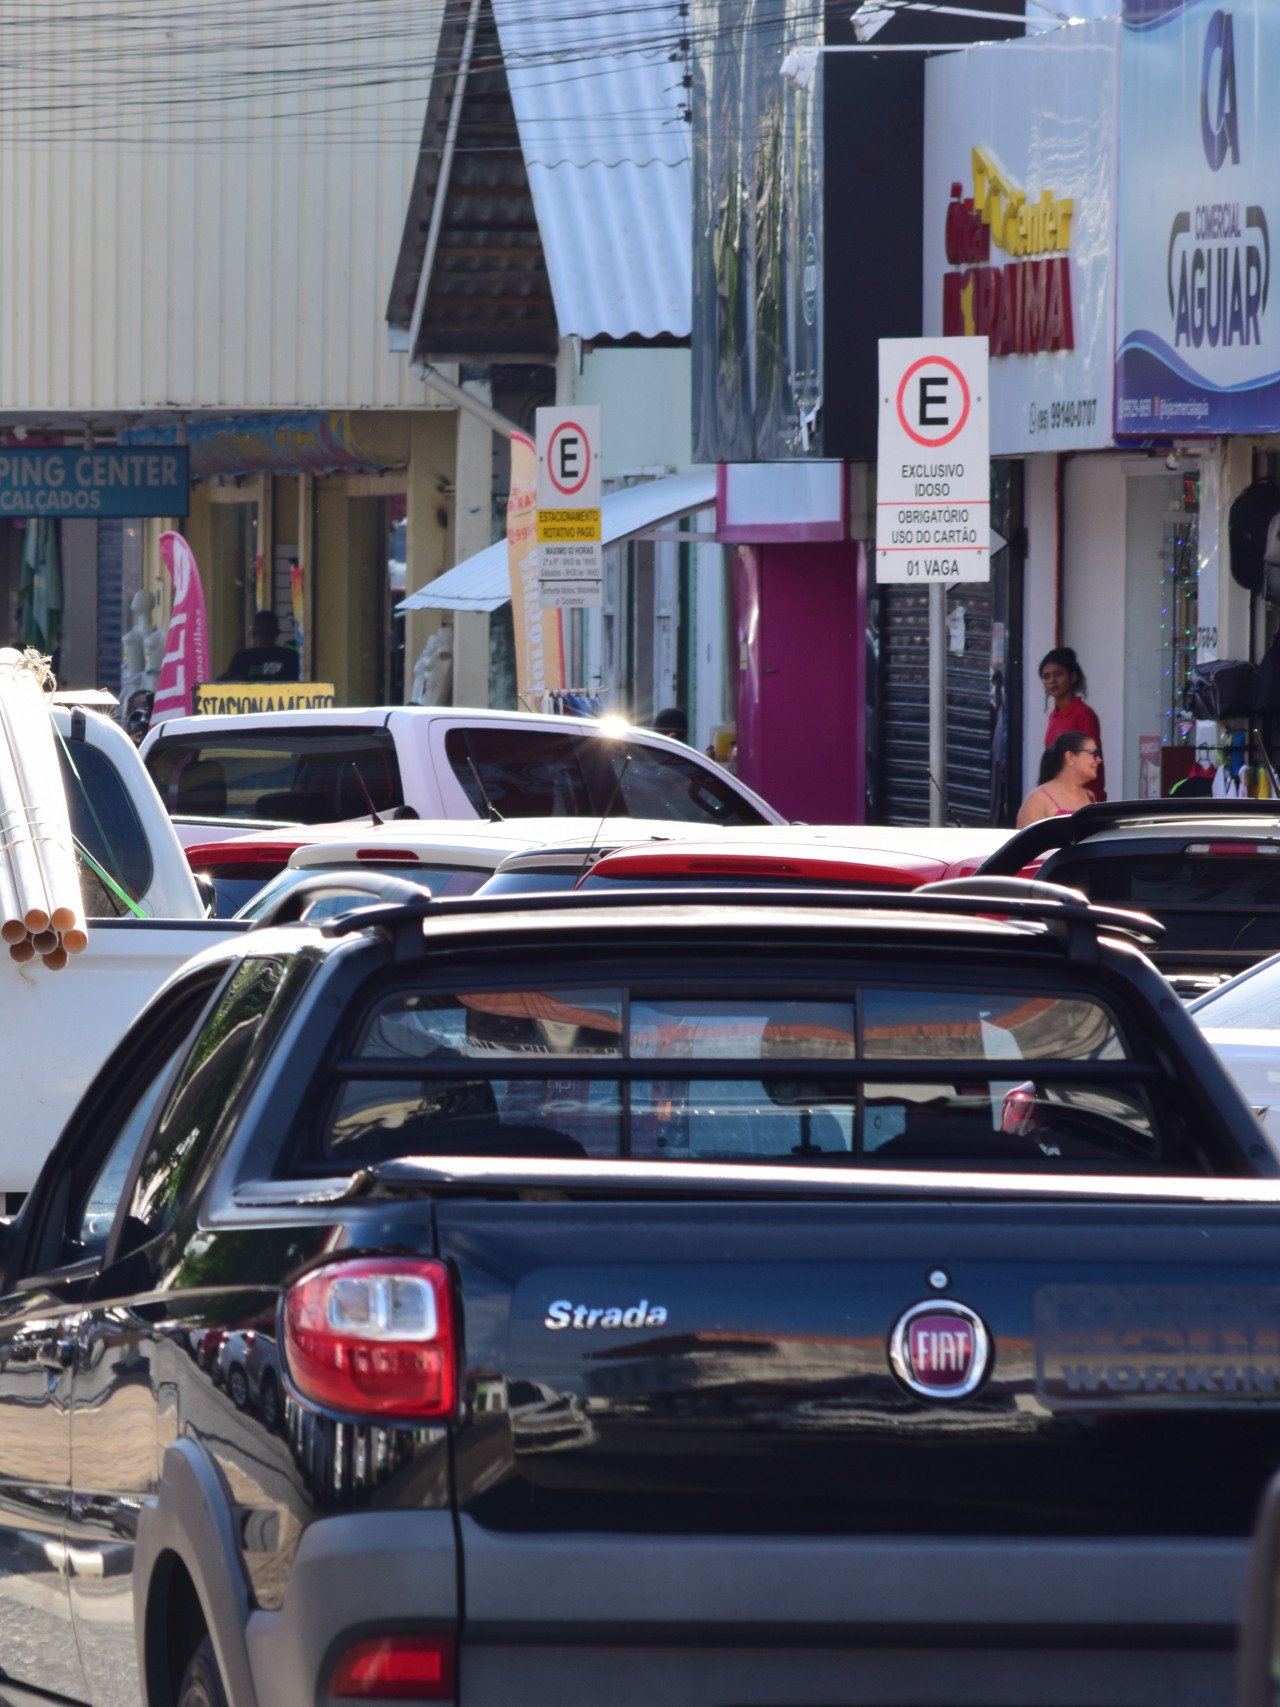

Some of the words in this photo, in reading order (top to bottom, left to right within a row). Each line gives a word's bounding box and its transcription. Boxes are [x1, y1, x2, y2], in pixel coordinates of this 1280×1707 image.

[1195, 203, 1241, 240] COMERCIAL
[1174, 246, 1261, 348] AGUIAR
[919, 377, 949, 425] E
[75, 455, 178, 486] CENTER
[560, 438, 579, 478] E
[901, 464, 964, 478] EXCLUSIVO
[0, 490, 101, 515] CALÇADOS
[914, 483, 950, 497] IDOSO
[539, 511, 599, 523] ESTACIONAMENTO
[898, 507, 969, 524] OBRIGATÓRIO
[543, 527, 575, 539] ROTATIVO
[577, 527, 595, 538] PAGO
[892, 531, 913, 544] USO
[916, 530, 931, 544] DO
[933, 526, 977, 544] CARTÃO
[907, 561, 920, 576] 01
[924, 560, 960, 576] VAGA
[544, 1299, 668, 1331] Strada
[917, 1331, 969, 1371] FIAT
